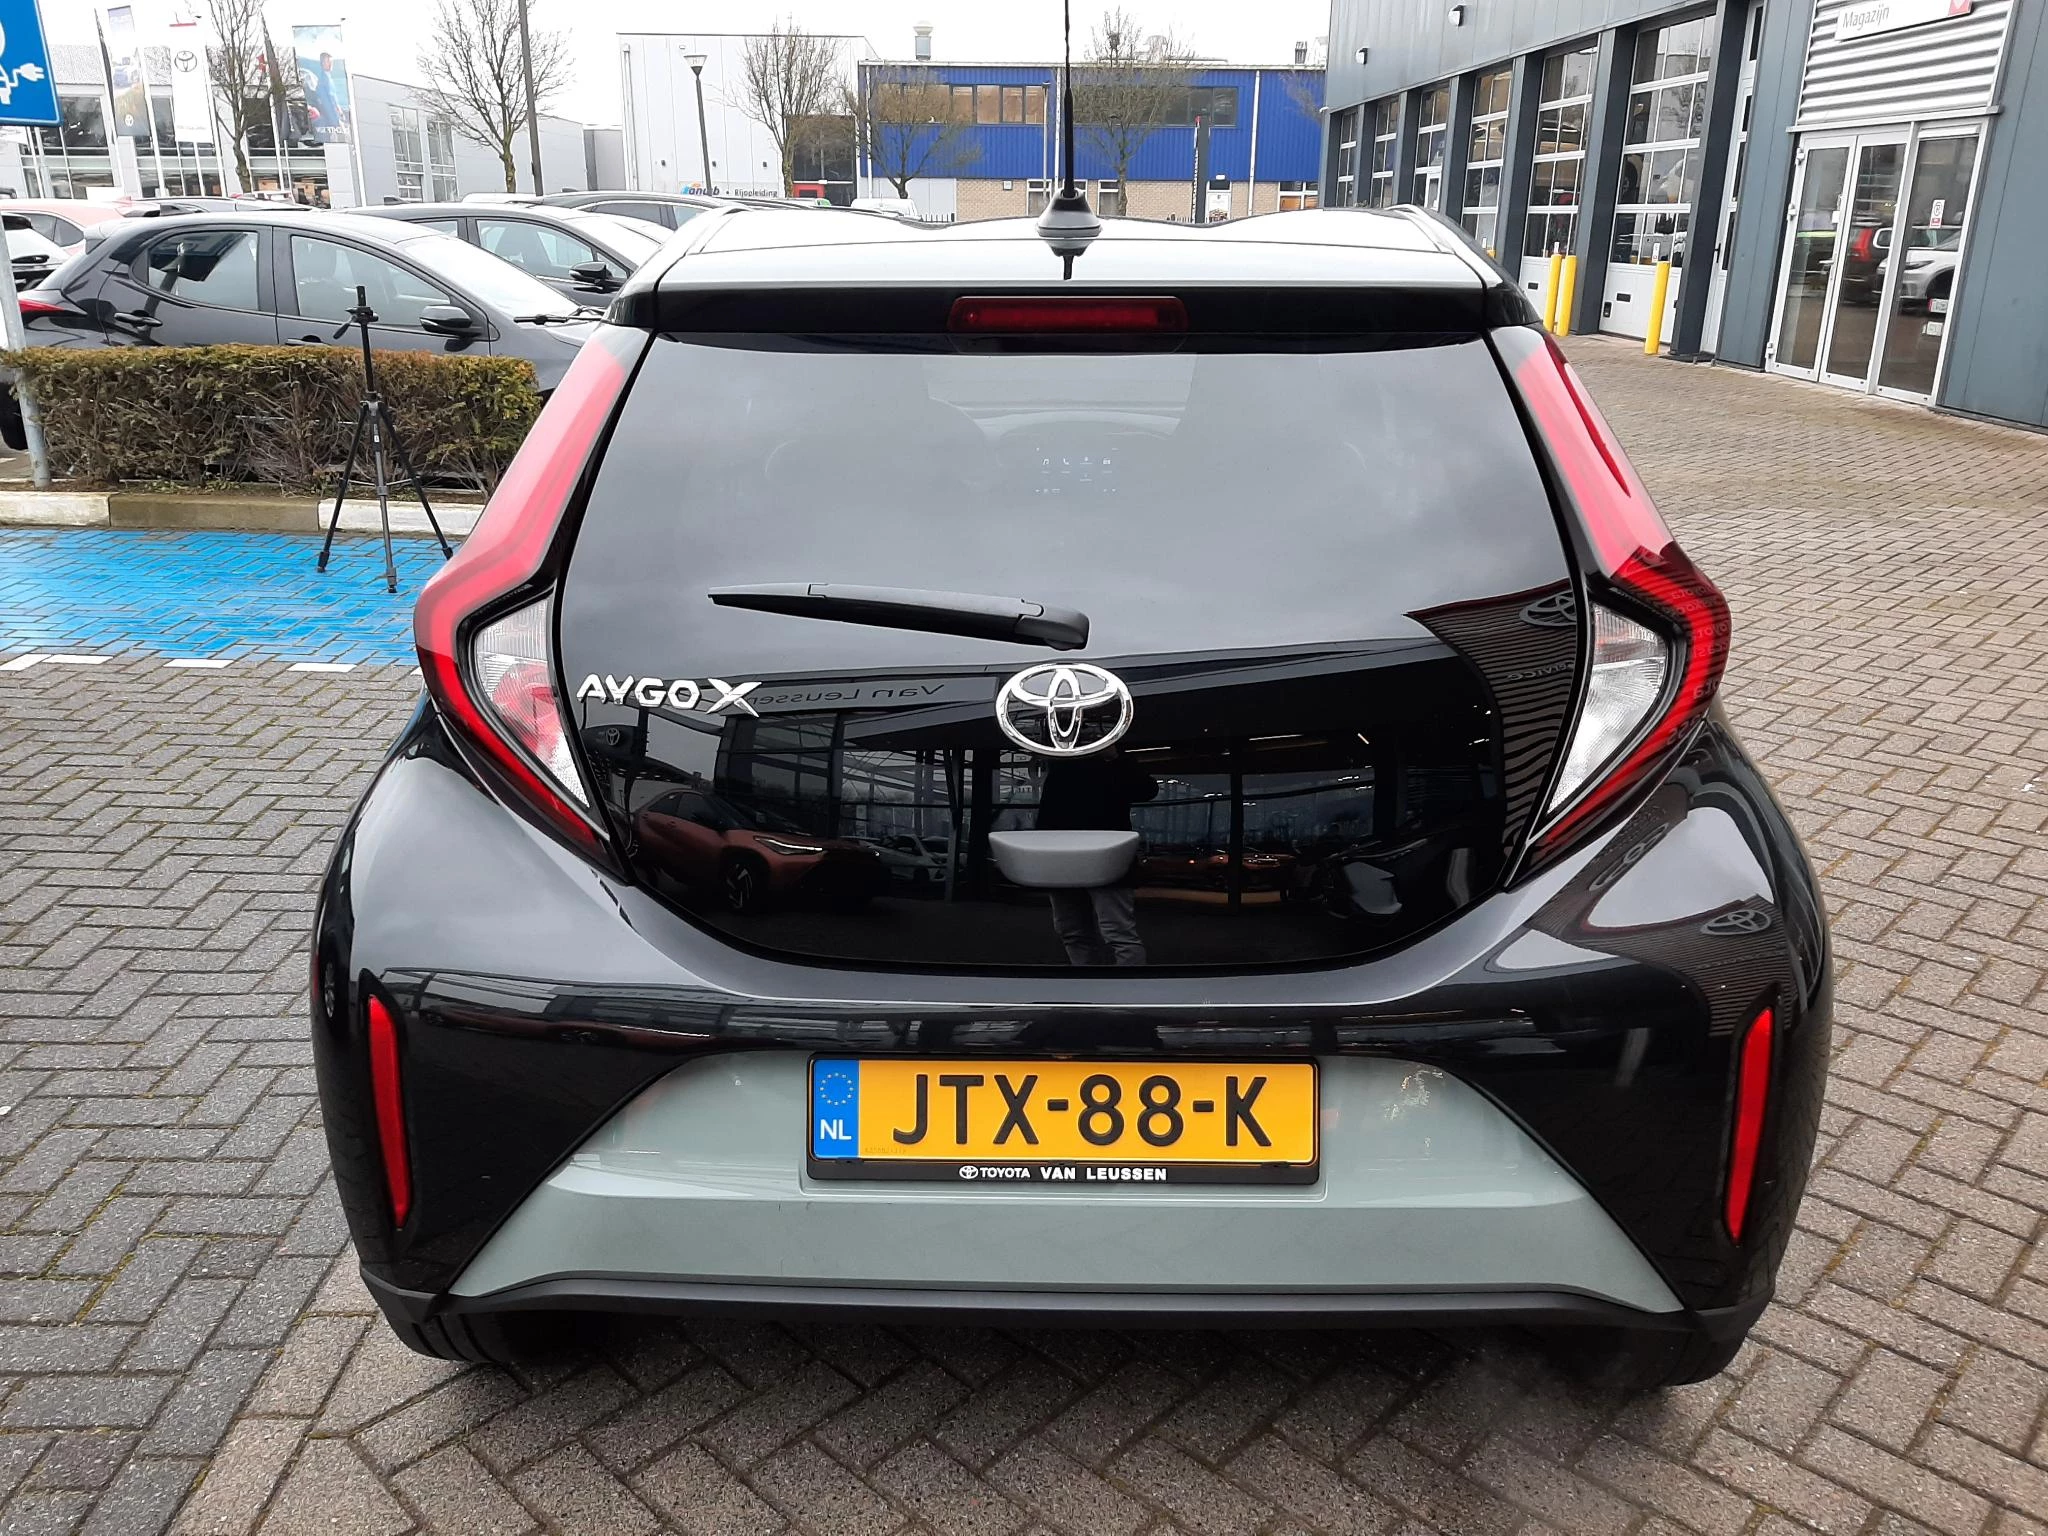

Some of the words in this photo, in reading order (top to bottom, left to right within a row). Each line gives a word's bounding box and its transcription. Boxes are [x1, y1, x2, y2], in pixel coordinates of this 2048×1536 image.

[1842, 4, 1890, 31] Magazijn
[892, 1073, 1272, 1147] JTX-88-K
[819, 1118, 852, 1141] NL
[980, 1166, 1031, 1179] TOYOTA
[1040, 1166, 1076, 1180] VAN
[1086, 1167, 1167, 1181] LEUSSEN
